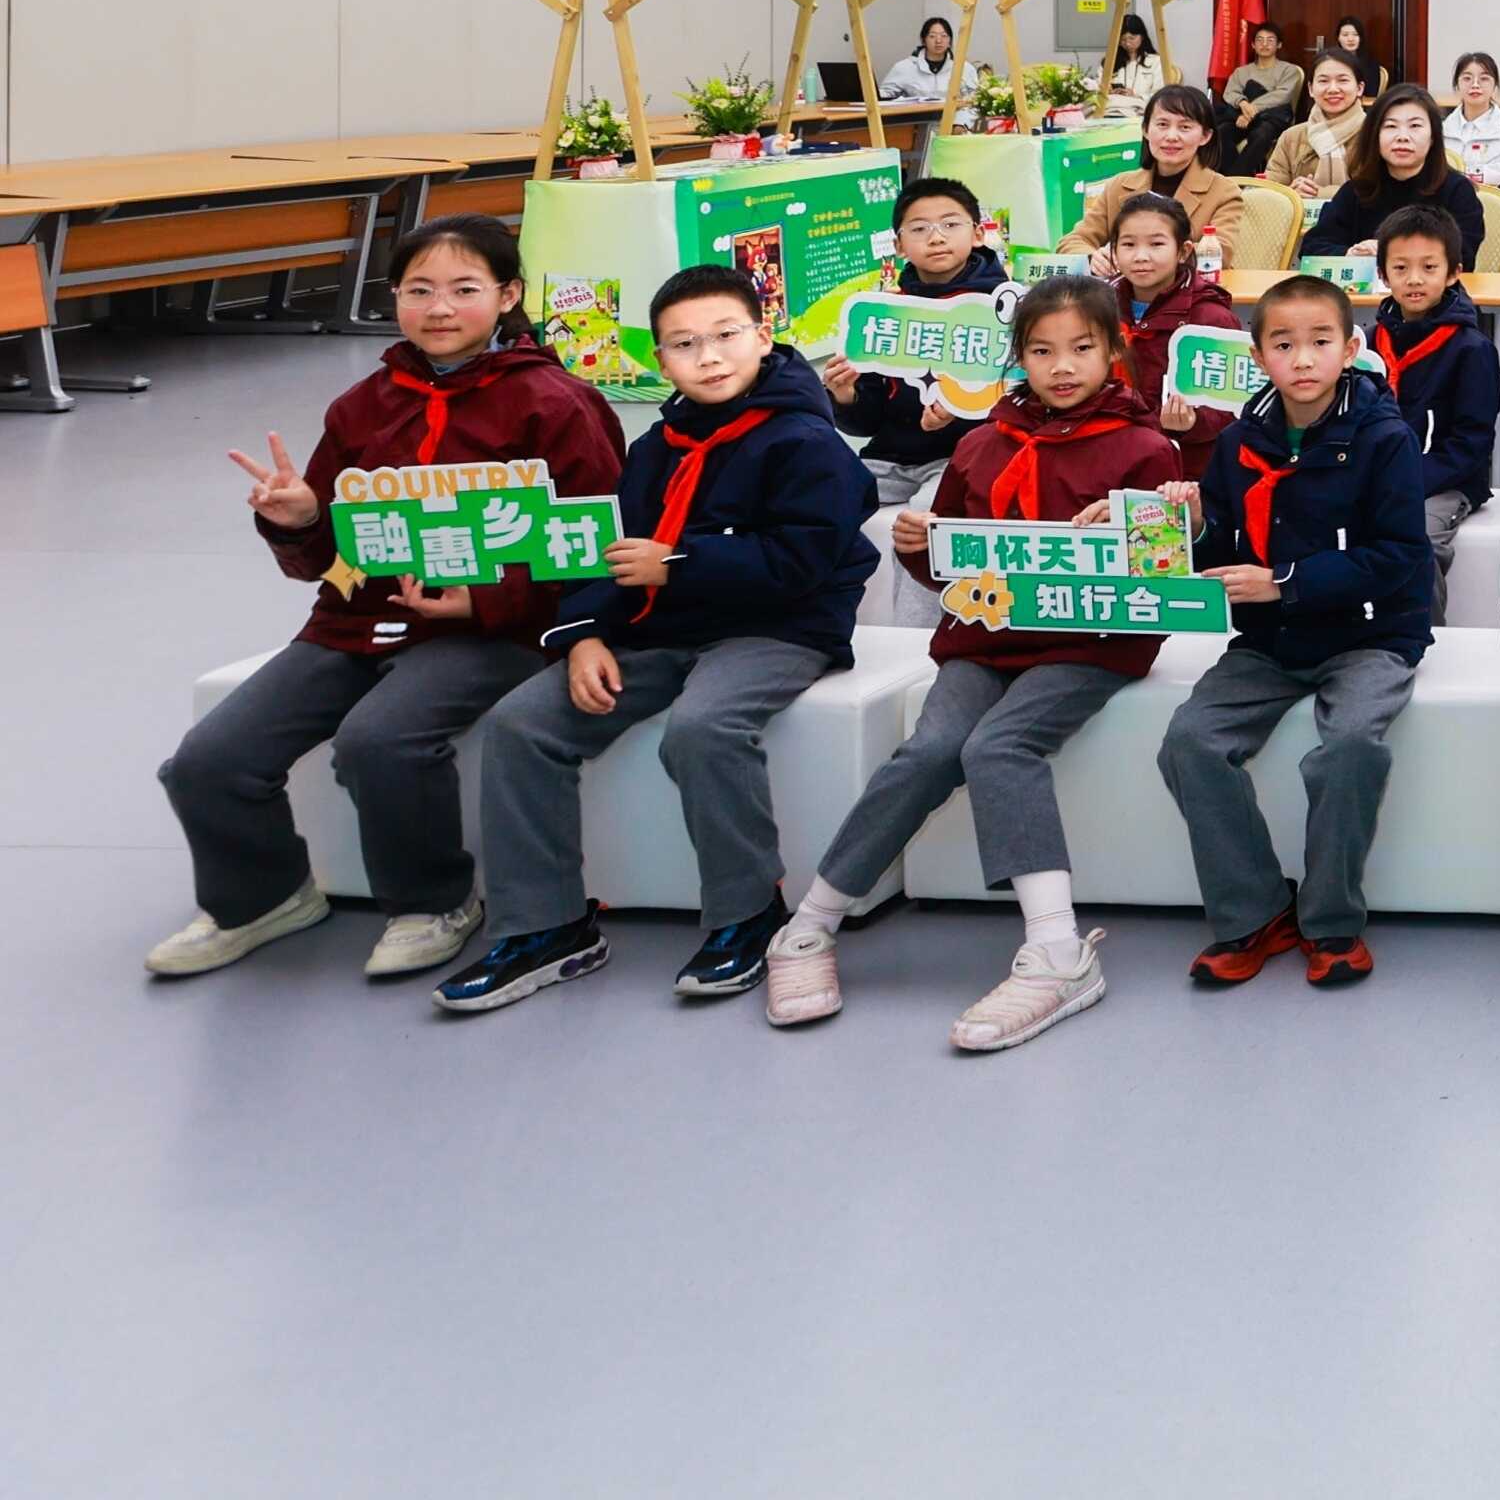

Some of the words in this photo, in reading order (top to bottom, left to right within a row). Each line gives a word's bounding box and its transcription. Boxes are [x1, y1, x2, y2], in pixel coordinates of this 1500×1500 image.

[340, 465, 538, 502] COUNTRY
[351, 497, 599, 578] 融惠乡村
[951, 533, 1119, 574] 胸怀天下
[1036, 583, 1206, 622] 知行合一
